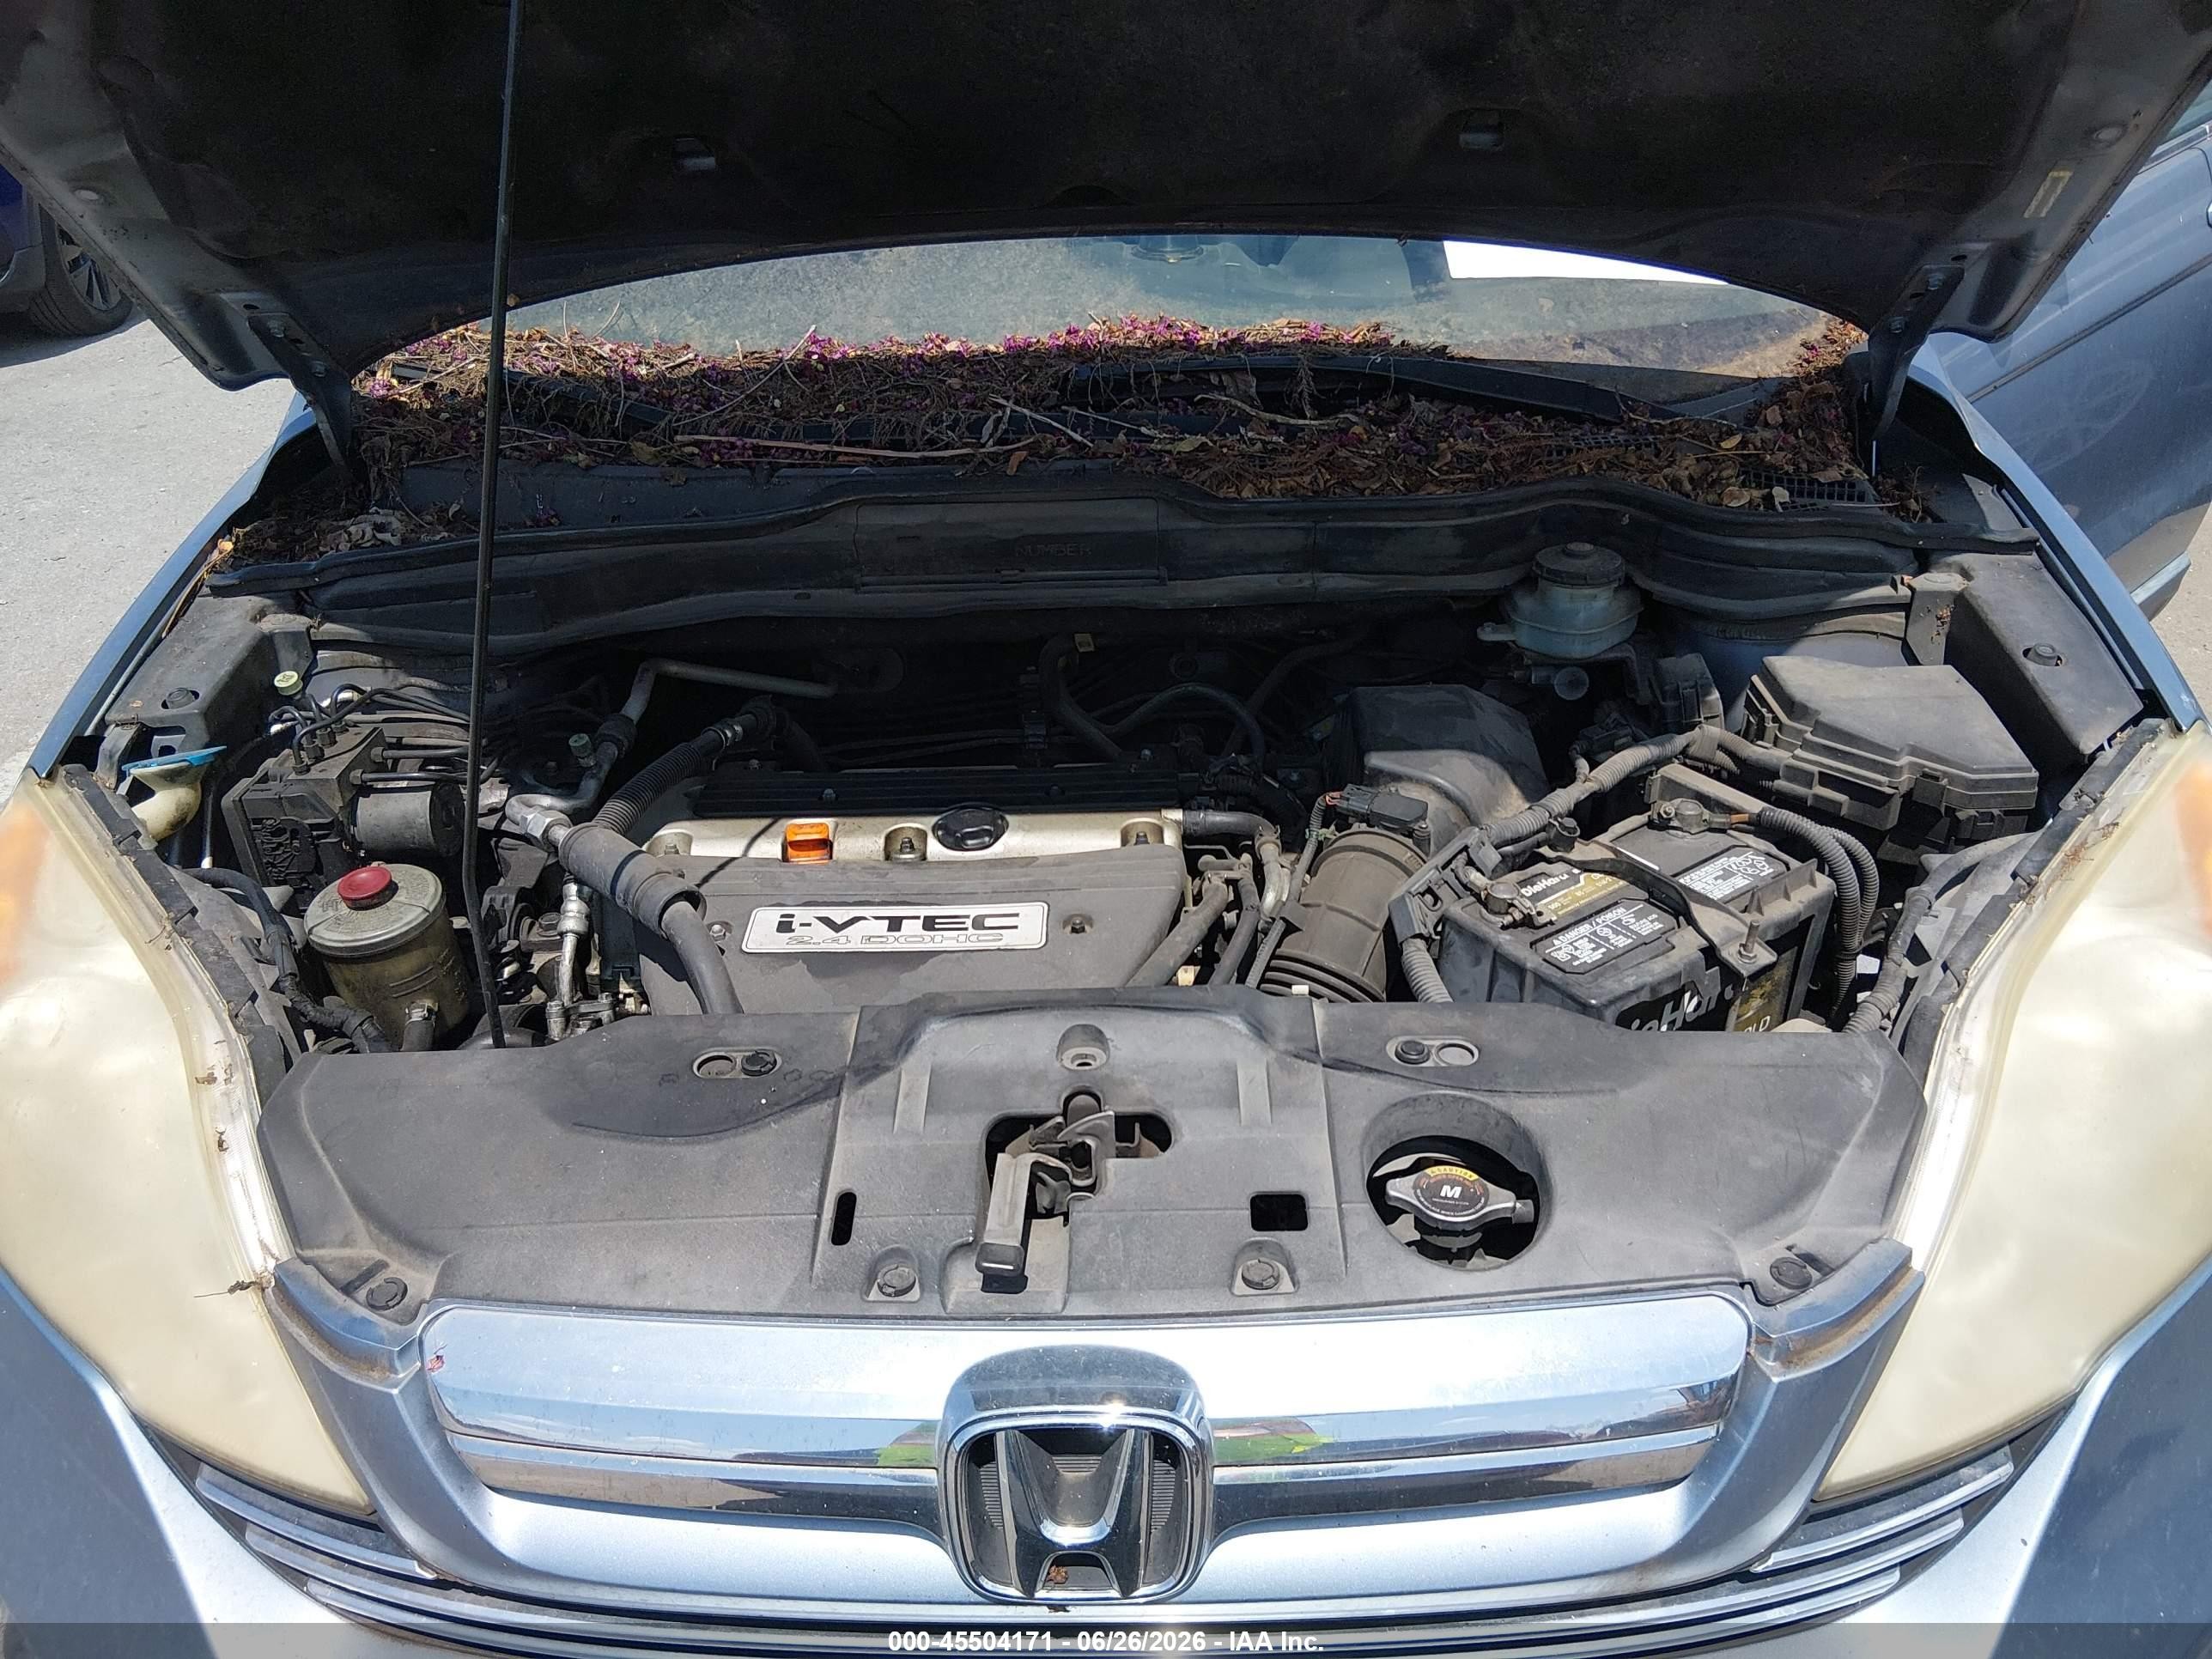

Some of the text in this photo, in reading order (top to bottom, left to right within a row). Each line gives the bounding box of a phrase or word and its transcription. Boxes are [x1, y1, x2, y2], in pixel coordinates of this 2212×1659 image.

[775, 913, 1020, 934] i-VTEC
[1561, 923, 1593, 942] DANGER
[1596, 907, 1627, 925] POISON
[786, 933, 1004, 945] 2.4 DOHC
[1440, 1185, 1462, 1199] M
